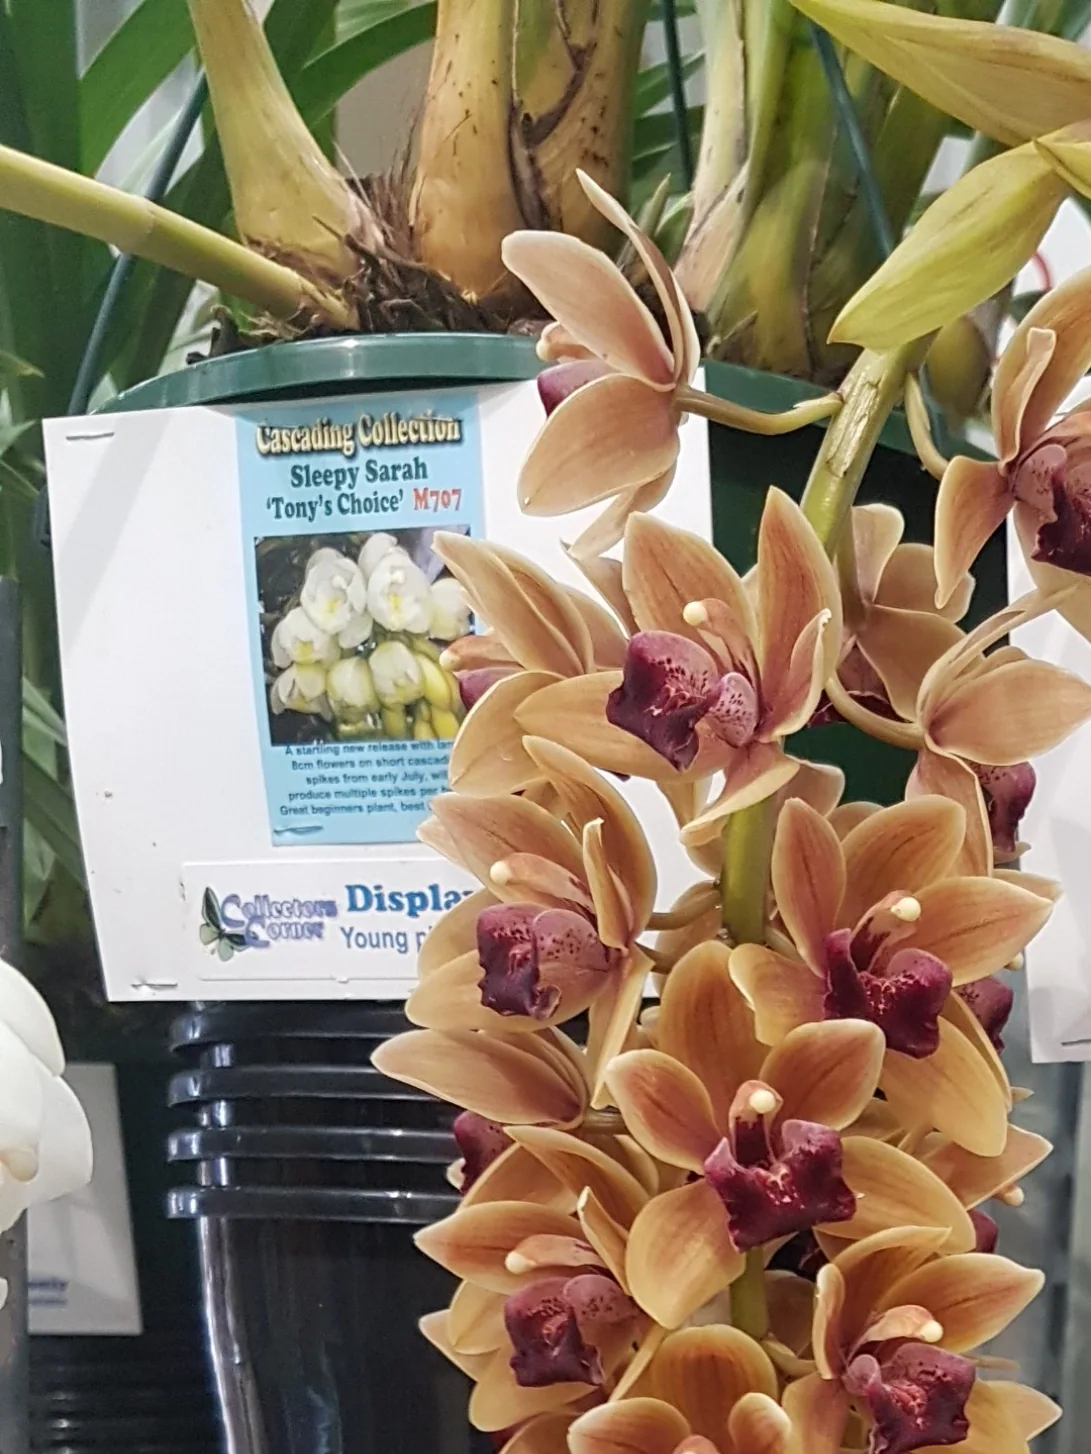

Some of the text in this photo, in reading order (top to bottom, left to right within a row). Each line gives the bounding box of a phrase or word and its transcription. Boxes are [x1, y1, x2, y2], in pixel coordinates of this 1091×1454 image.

[256, 409, 462, 457] Cascading Collection
[291, 456, 428, 490] Sleepy Sarah
[413, 487, 462, 512] M707
[286, 744, 293, 756] A
[296, 743, 340, 757] startling
[343, 745, 364, 753] new
[368, 742, 407, 752] release
[411, 741, 434, 750] with
[292, 760, 313, 770] 8cm
[317, 759, 355, 769] flowers
[376, 757, 405, 767] short
[408, 755, 448, 766] cascad
[306, 775, 340, 787] spikes
[343, 773, 368, 783] from
[372, 772, 398, 785] early
[402, 771, 428, 784] July,
[288, 790, 331, 802] produce
[334, 788, 377, 799] multiple
[381, 786, 416, 798] spikes
[420, 787, 438, 797] per
[280, 805, 308, 816] Great
[311, 804, 364, 816] beginners
[367, 803, 397, 815] plant,
[401, 800, 425, 811] best
[220, 893, 338, 928] Collectors
[245, 917, 326, 948] Corner
[340, 927, 409, 953] Young
